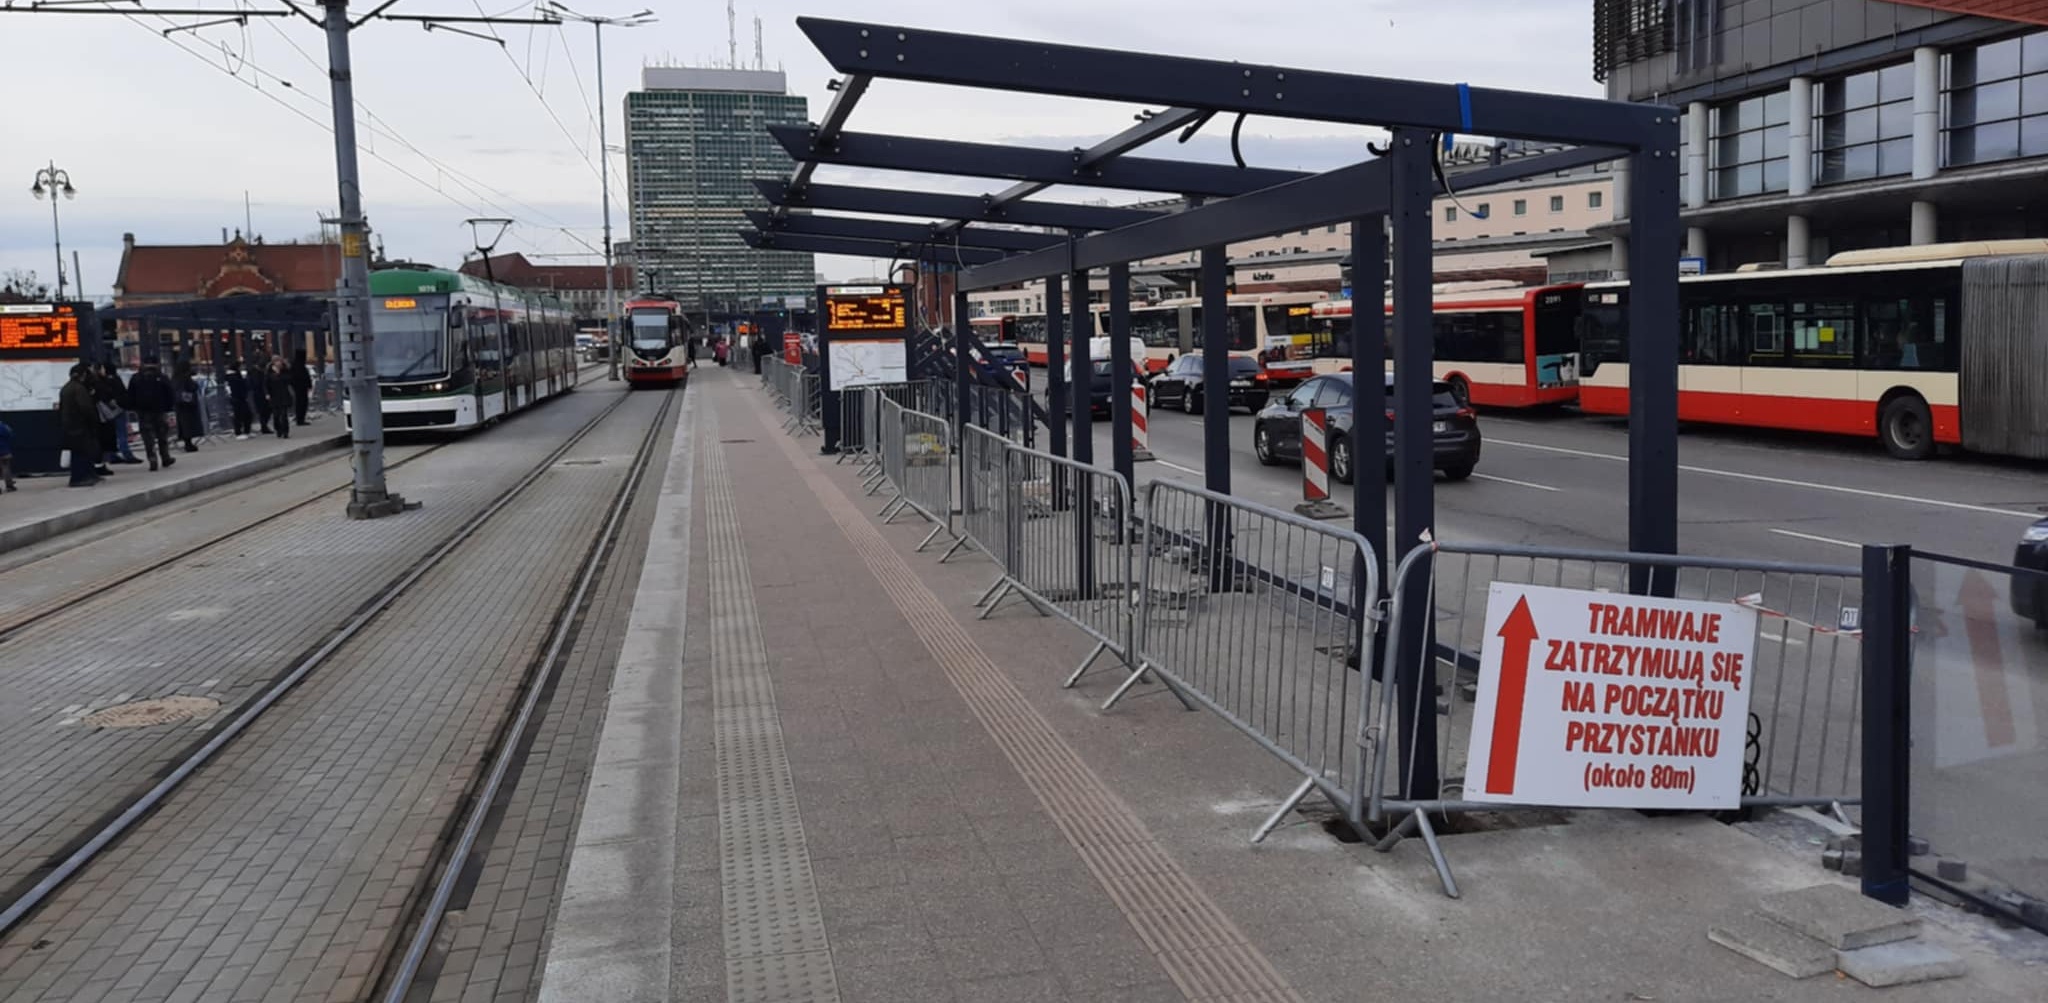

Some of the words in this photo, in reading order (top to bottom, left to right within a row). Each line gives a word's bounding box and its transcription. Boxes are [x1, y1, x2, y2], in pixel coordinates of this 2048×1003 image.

[1588, 602, 1722, 644] TRAMWAJE
[1544, 639, 1705, 689] ZATRZYMUJĄ
[1710, 651, 1744, 691] SIĘ
[1561, 680, 1596, 714] NA
[1603, 683, 1725, 727] POCZĄTKU
[1565, 721, 1720, 758] PRZYSTANKU
[1584, 762, 1646, 792] (około
[1650, 764, 1696, 794] 80m)
